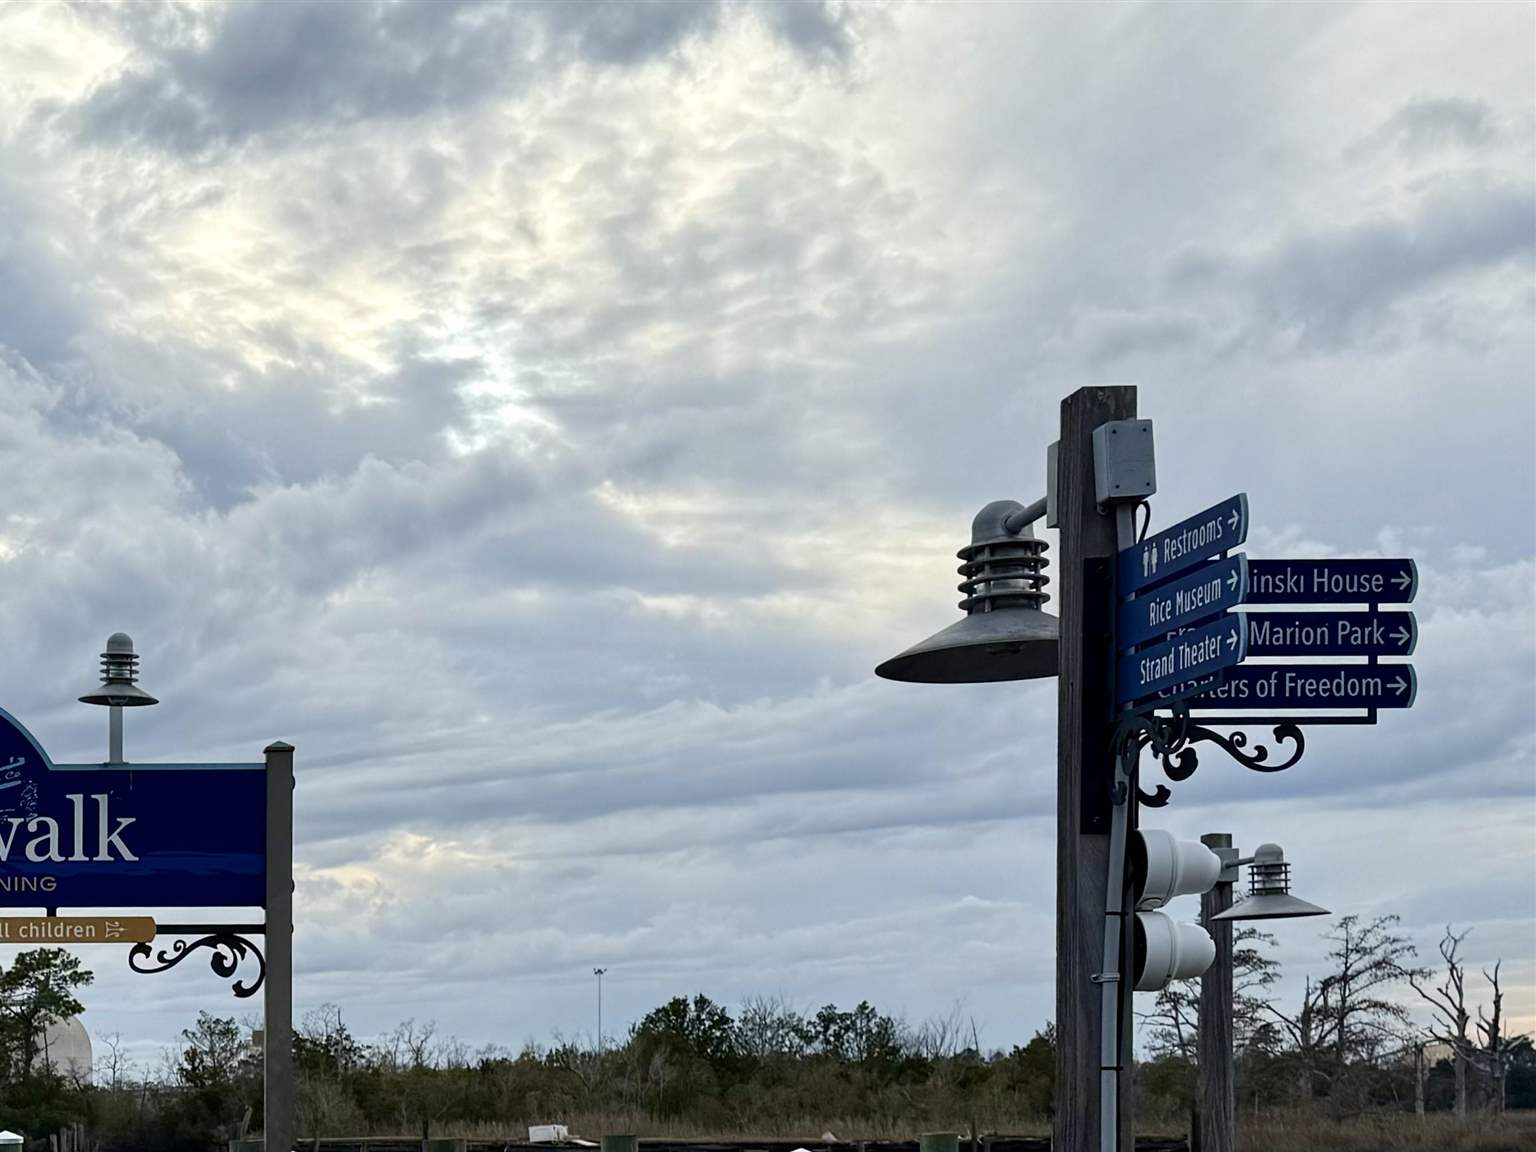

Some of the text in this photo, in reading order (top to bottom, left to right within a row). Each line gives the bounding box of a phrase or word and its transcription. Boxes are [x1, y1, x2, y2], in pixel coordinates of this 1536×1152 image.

[1163, 515, 1223, 563] Restrooms
[1247, 567, 1384, 594] inski House
[1149, 577, 1222, 627] Rice Museum
[1250, 618, 1385, 646] Marion Park
[1139, 647, 1175, 686] Strand
[1178, 634, 1223, 671] Theater
[1255, 671, 1279, 698] of
[1284, 670, 1383, 698] Freedom
[18, 922, 96, 938] children
